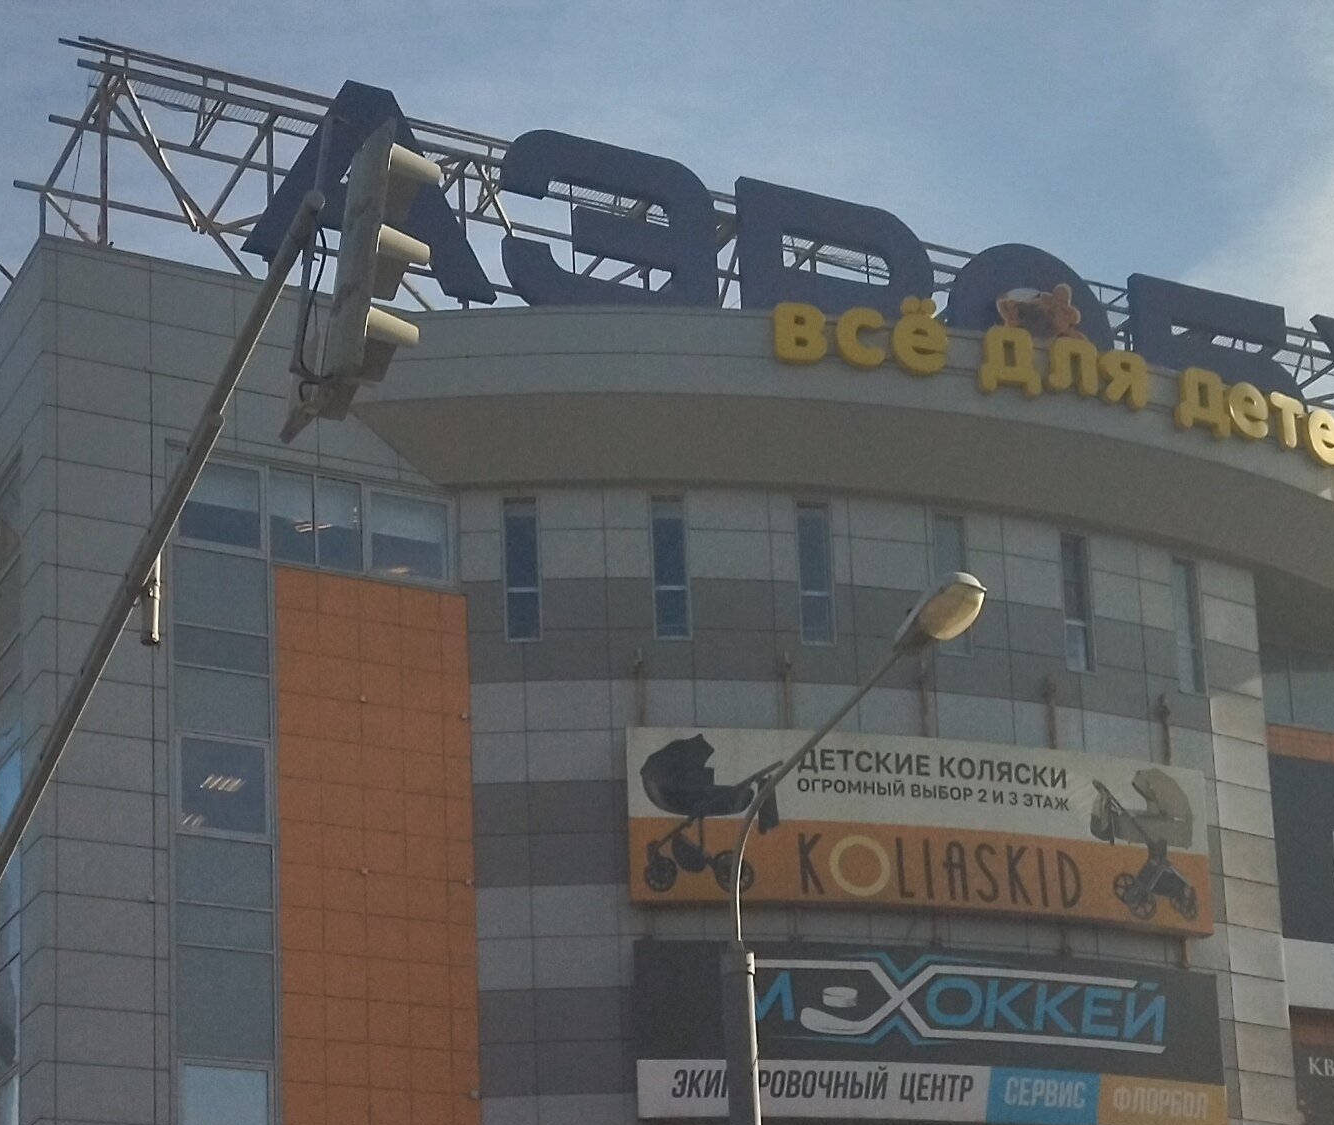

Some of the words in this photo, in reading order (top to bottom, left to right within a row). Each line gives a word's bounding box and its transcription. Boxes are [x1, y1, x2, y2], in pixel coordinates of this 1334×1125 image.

[797, 746, 931, 779] ДЕТСКИЕ
[940, 756, 1068, 789] КОЛЯСКИ
[797, 776, 906, 799] ОГРОМНЫЙ
[911, 782, 973, 802] ВЫБОР
[977, 788, 988, 804] 2
[992, 789, 1004, 805] И
[1008, 790, 1018, 806] 3
[1023, 792, 1070, 812] ЭТАЖ
[797, 832, 1083, 909] KOLIASKID
[672, 1064, 889, 1101] ЭКИРОВОЧНЫЙ
[900, 1071, 974, 1104] ЦЕНТР
[1004, 1076, 1086, 1109] СЕРВИС
[1113, 1088, 1208, 1121] ФЛОРБОЛ
